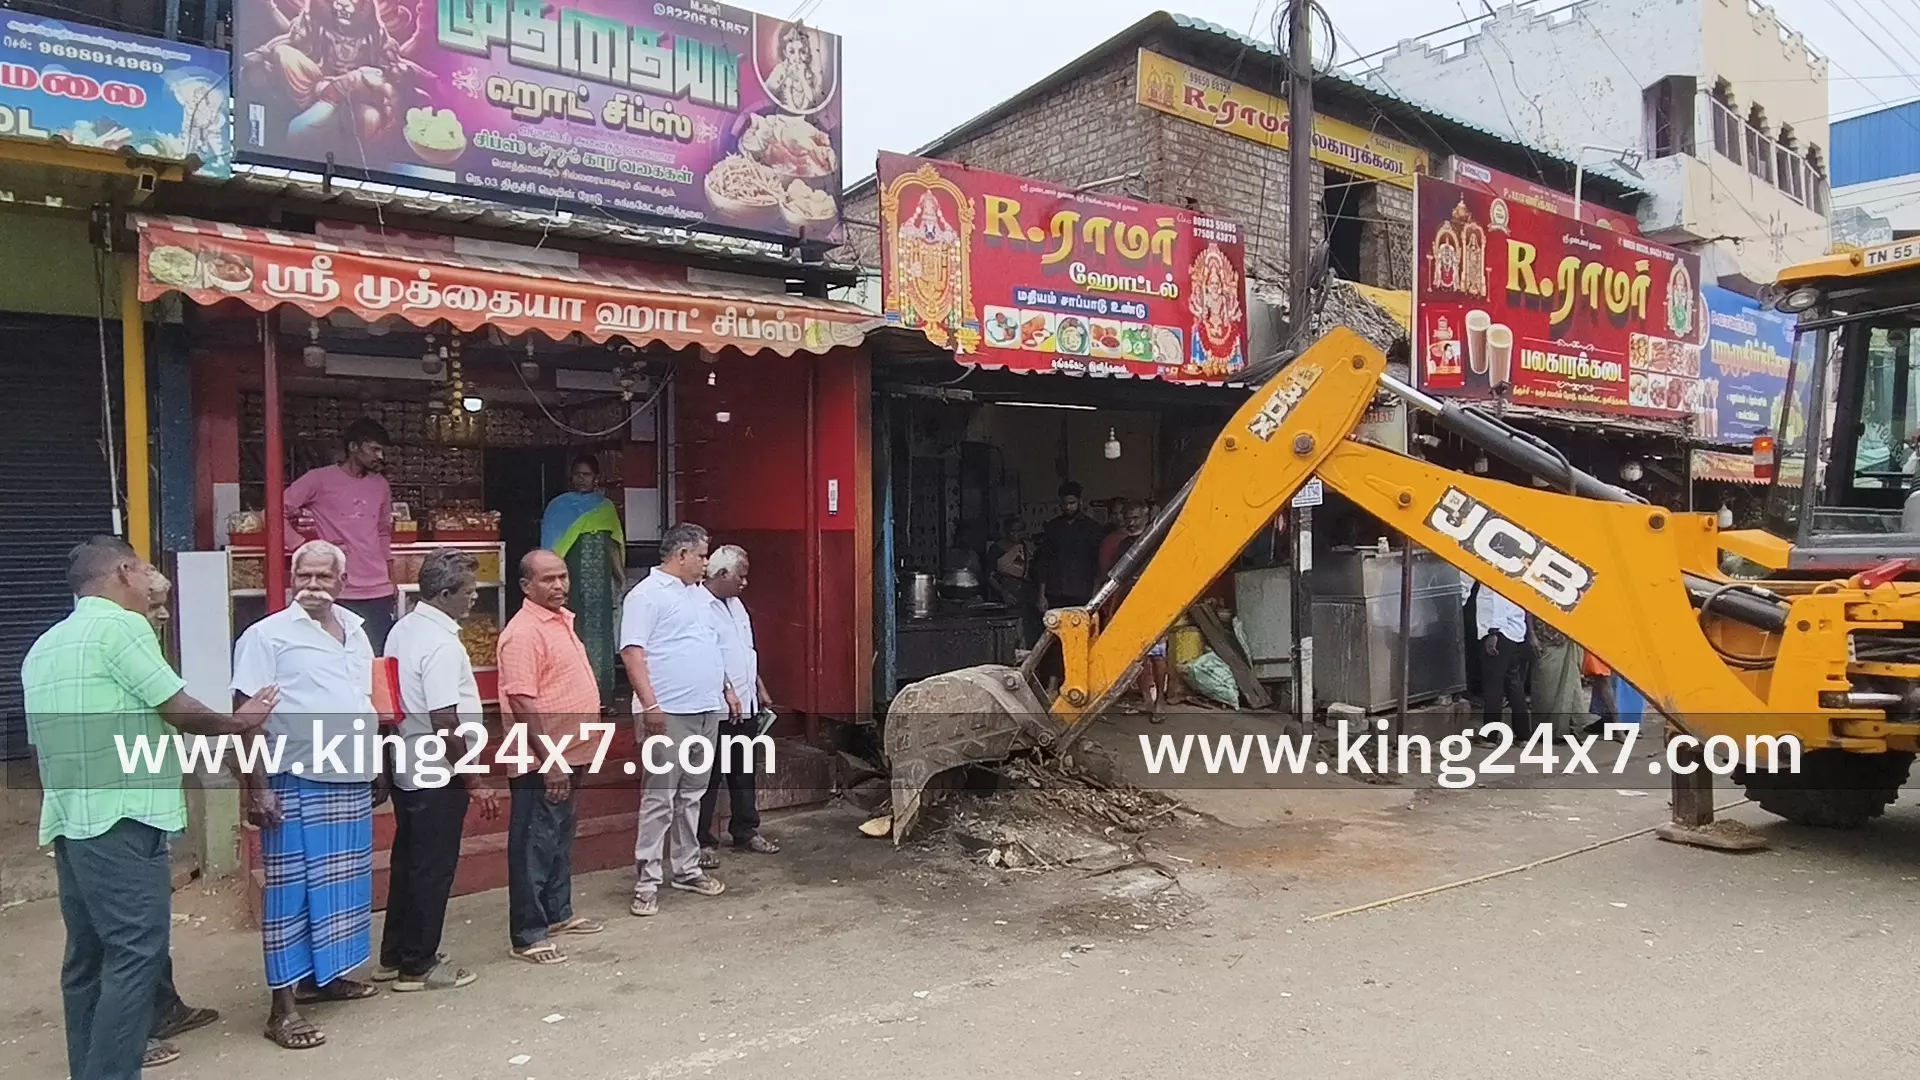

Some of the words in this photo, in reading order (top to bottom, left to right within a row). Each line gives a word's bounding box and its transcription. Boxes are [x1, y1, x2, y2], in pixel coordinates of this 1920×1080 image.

[666, 5, 707, 25] 82205
[38, 42, 165, 74] 9698914969
[486, 75, 596, 121] ஹாட்
[603, 91, 694, 143] சிப்ஸ்
[473, 129, 526, 155] சிப்ஸ்
[528, 142, 580, 167] மற்றும்
[583, 152, 617, 171] கார
[619, 160, 693, 184] வகைகள்
[1311, 132, 1407, 176] லகாரக்கடை
[983, 193, 1178, 266] R.ராமர்
[1868, 250, 1887, 264] TN
[1894, 244, 1912, 259] 55
[1069, 262, 1180, 299] ஹோட்டல்
[1505, 239, 1651, 325] R.ராமர்
[354, 268, 586, 322] முத்தையா
[594, 300, 703, 333] ஹாட்
[711, 307, 801, 342] சிப்ஸ்
[1017, 289, 1057, 305] மதியம்
[1060, 295, 1107, 314] சாப்பாடு
[1110, 301, 1146, 319] உண்டு
[1521, 348, 1626, 383] பலகாரக்கடை
[1431, 489, 1589, 606] JCB
